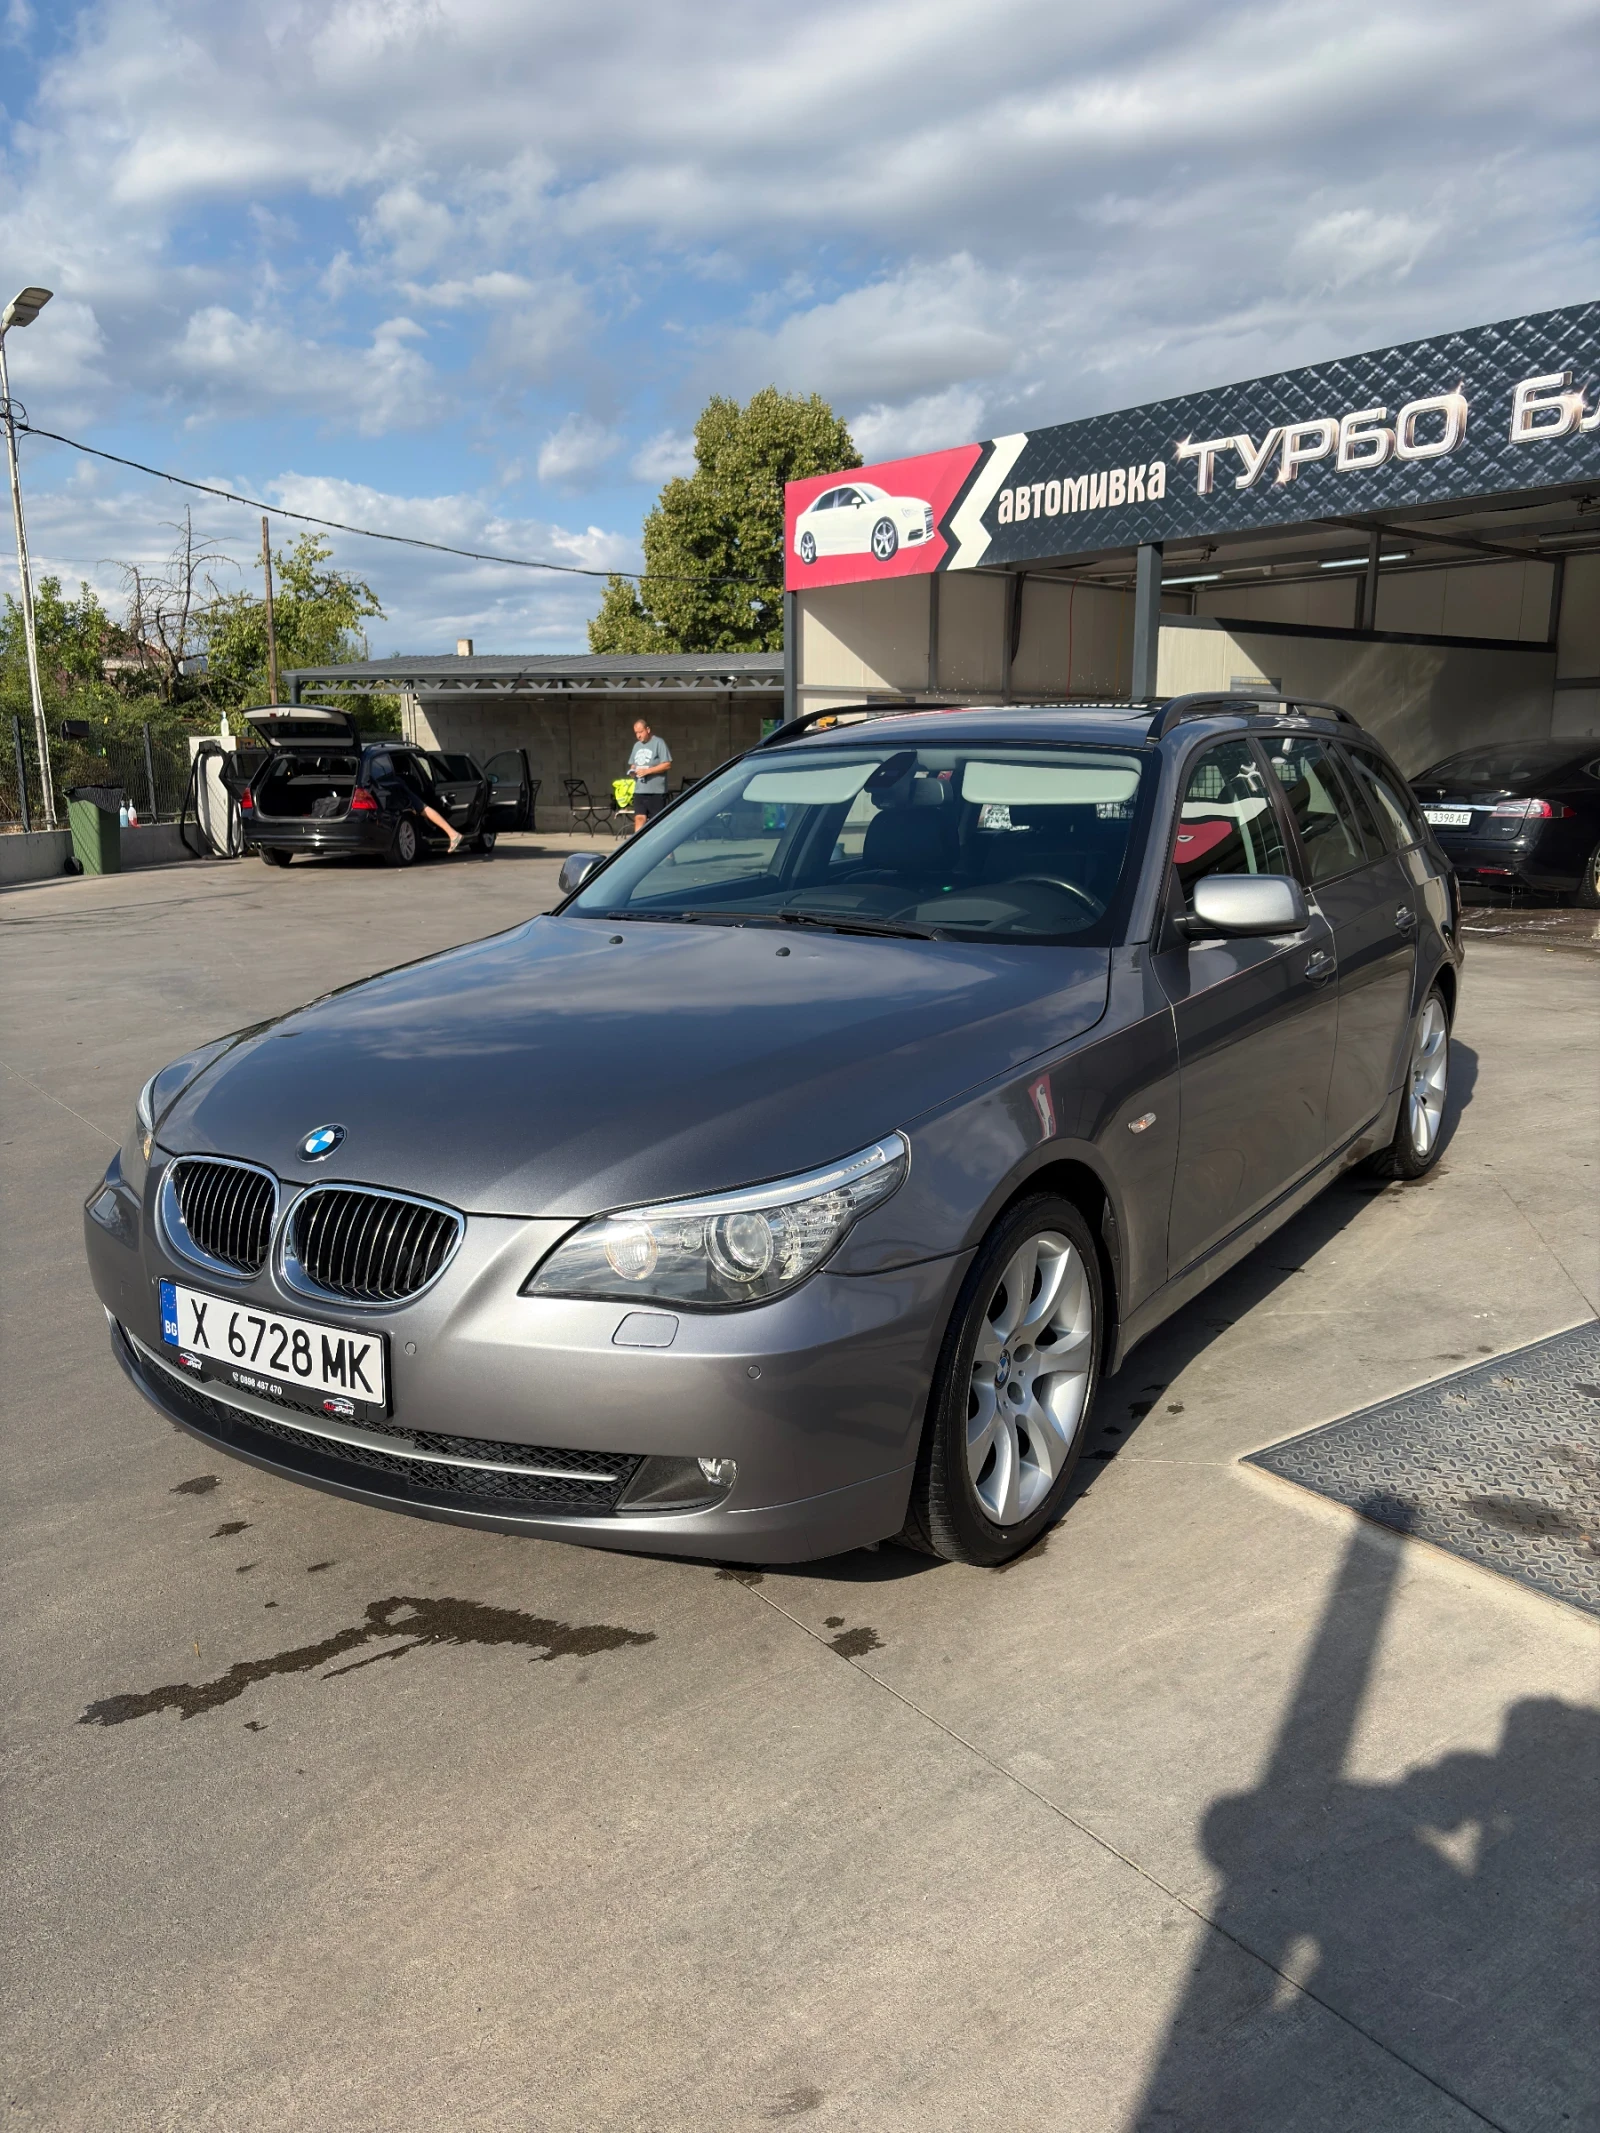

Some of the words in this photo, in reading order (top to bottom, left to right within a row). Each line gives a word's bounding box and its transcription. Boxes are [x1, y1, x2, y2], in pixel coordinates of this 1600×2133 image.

[1178, 392, 1469, 496] ТУРБО
[998, 461, 1166, 524] автомивка
[1432, 812, 1454, 823] 3398
[165, 1320, 178, 1337] BG
[190, 1298, 211, 1349] X
[228, 1312, 313, 1377] 6728
[321, 1332, 374, 1394] MK
[270, 1384, 283, 1395] 470
